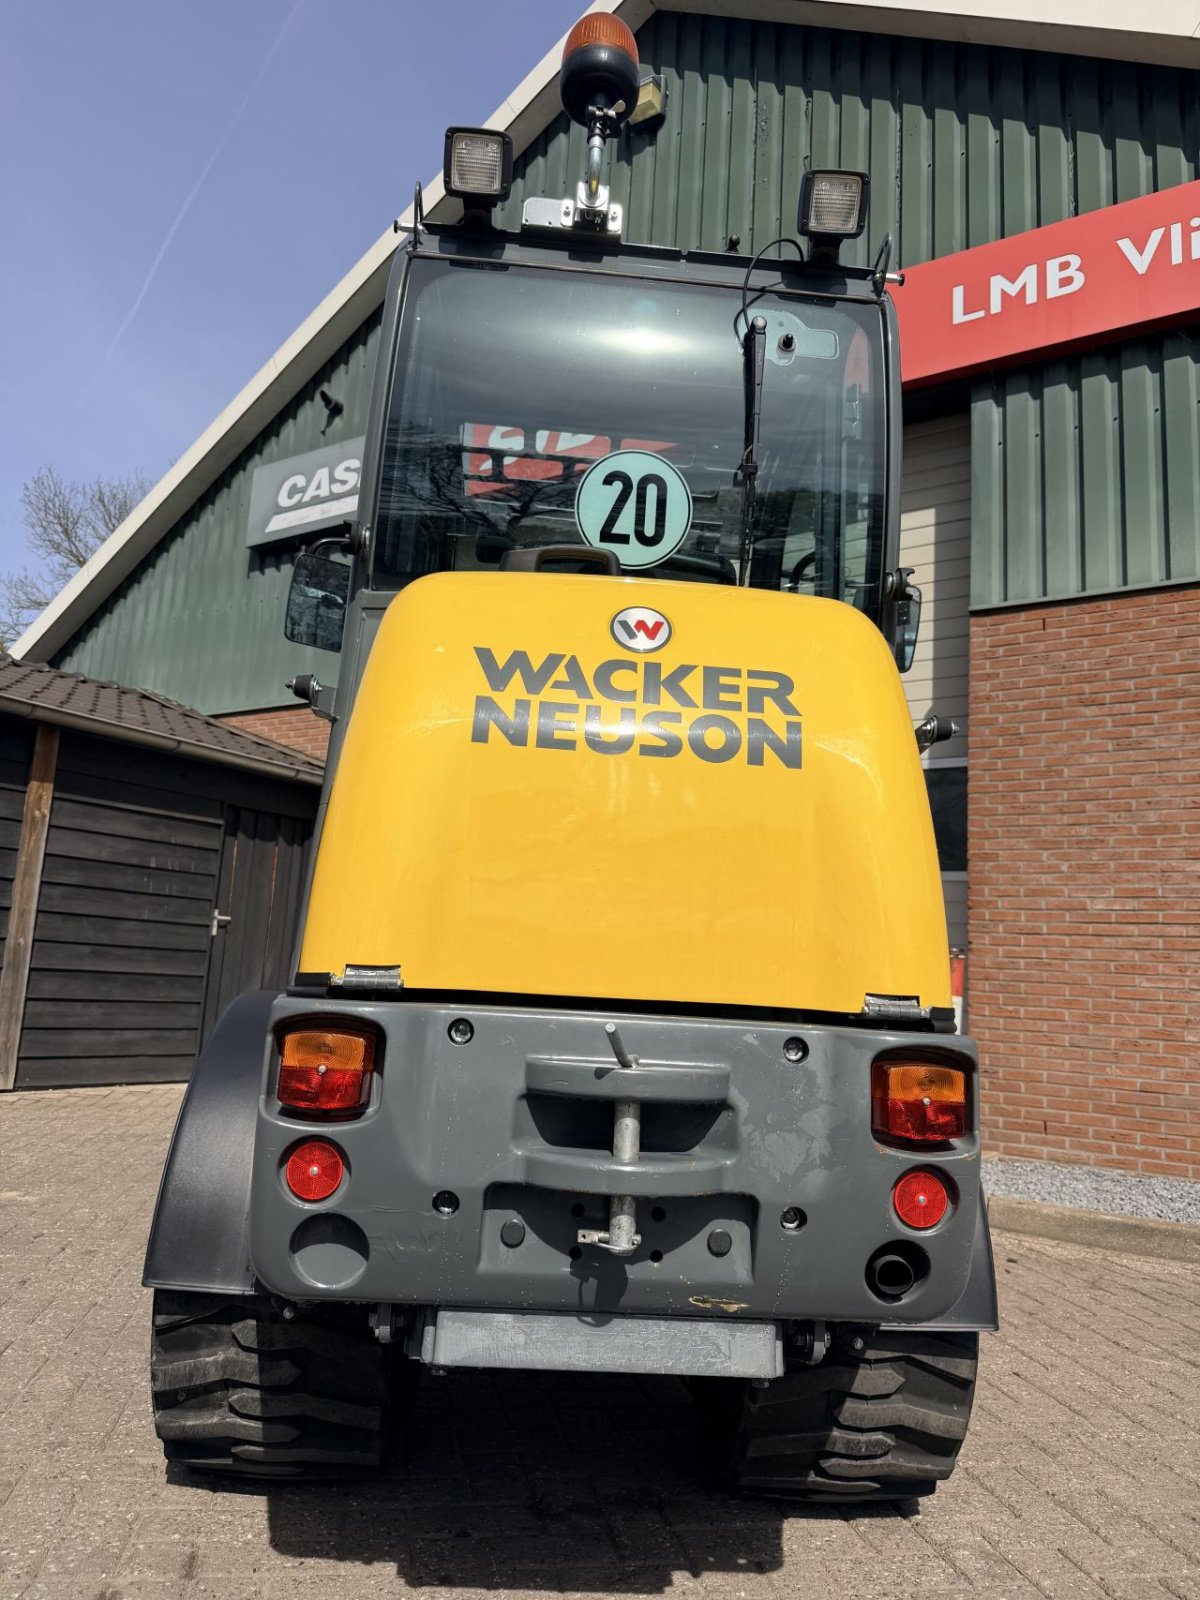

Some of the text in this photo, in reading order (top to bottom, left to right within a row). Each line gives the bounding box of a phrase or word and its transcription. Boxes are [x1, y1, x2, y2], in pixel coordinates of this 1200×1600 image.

[952, 253, 1085, 325] LMB
[277, 458, 361, 507] CAS
[599, 470, 668, 547] 20
[473, 647, 803, 716] WACKER
[471, 695, 802, 769] NEUSON
